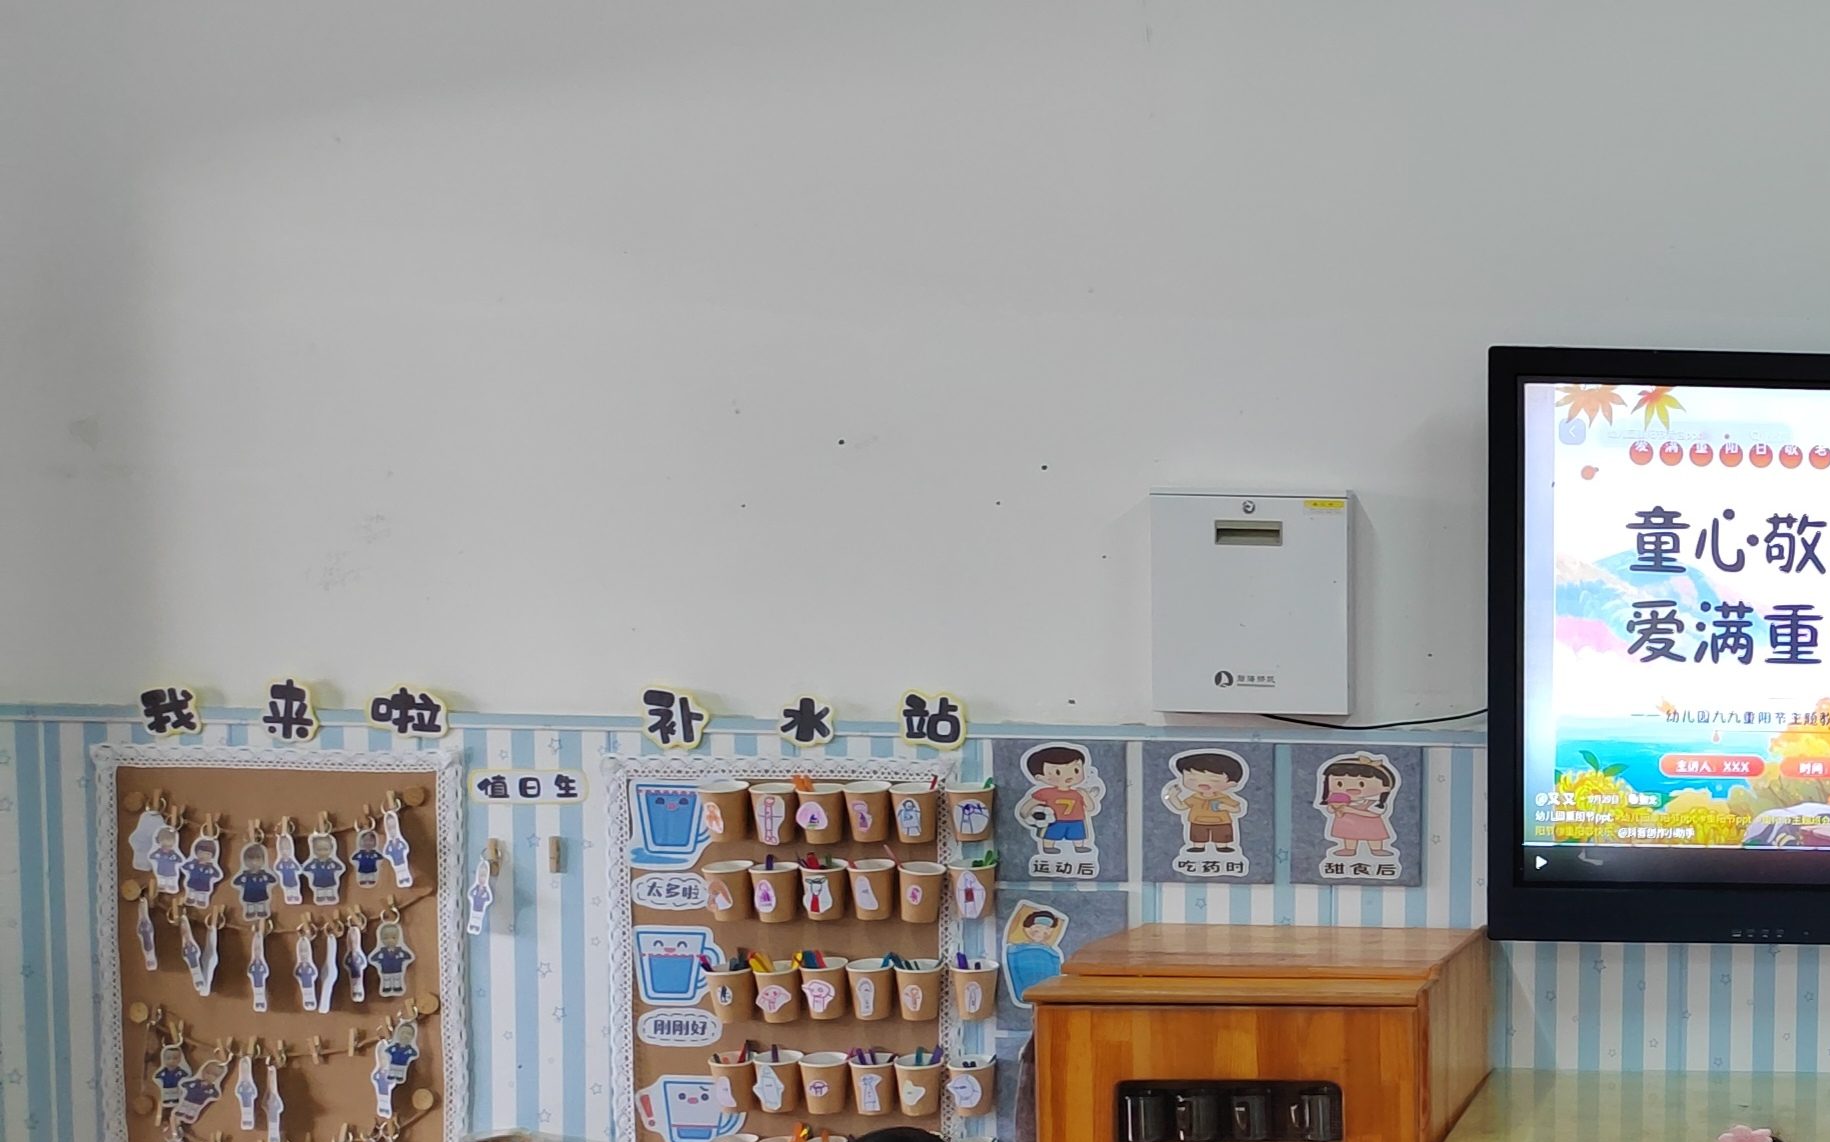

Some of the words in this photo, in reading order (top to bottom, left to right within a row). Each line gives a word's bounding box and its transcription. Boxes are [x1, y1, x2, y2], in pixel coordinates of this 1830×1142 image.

[141, 679, 441, 739] 我来啦
[643, 689, 960, 744] 补水站
[477, 774, 578, 798] 值日生
[1033, 860, 1095, 876] 运动后
[1178, 860, 1244, 874] 吃药时
[1324, 862, 1397, 876] 甜食后
[647, 882, 700, 900] 太多啦
[653, 1019, 707, 1036] 刚刚好
